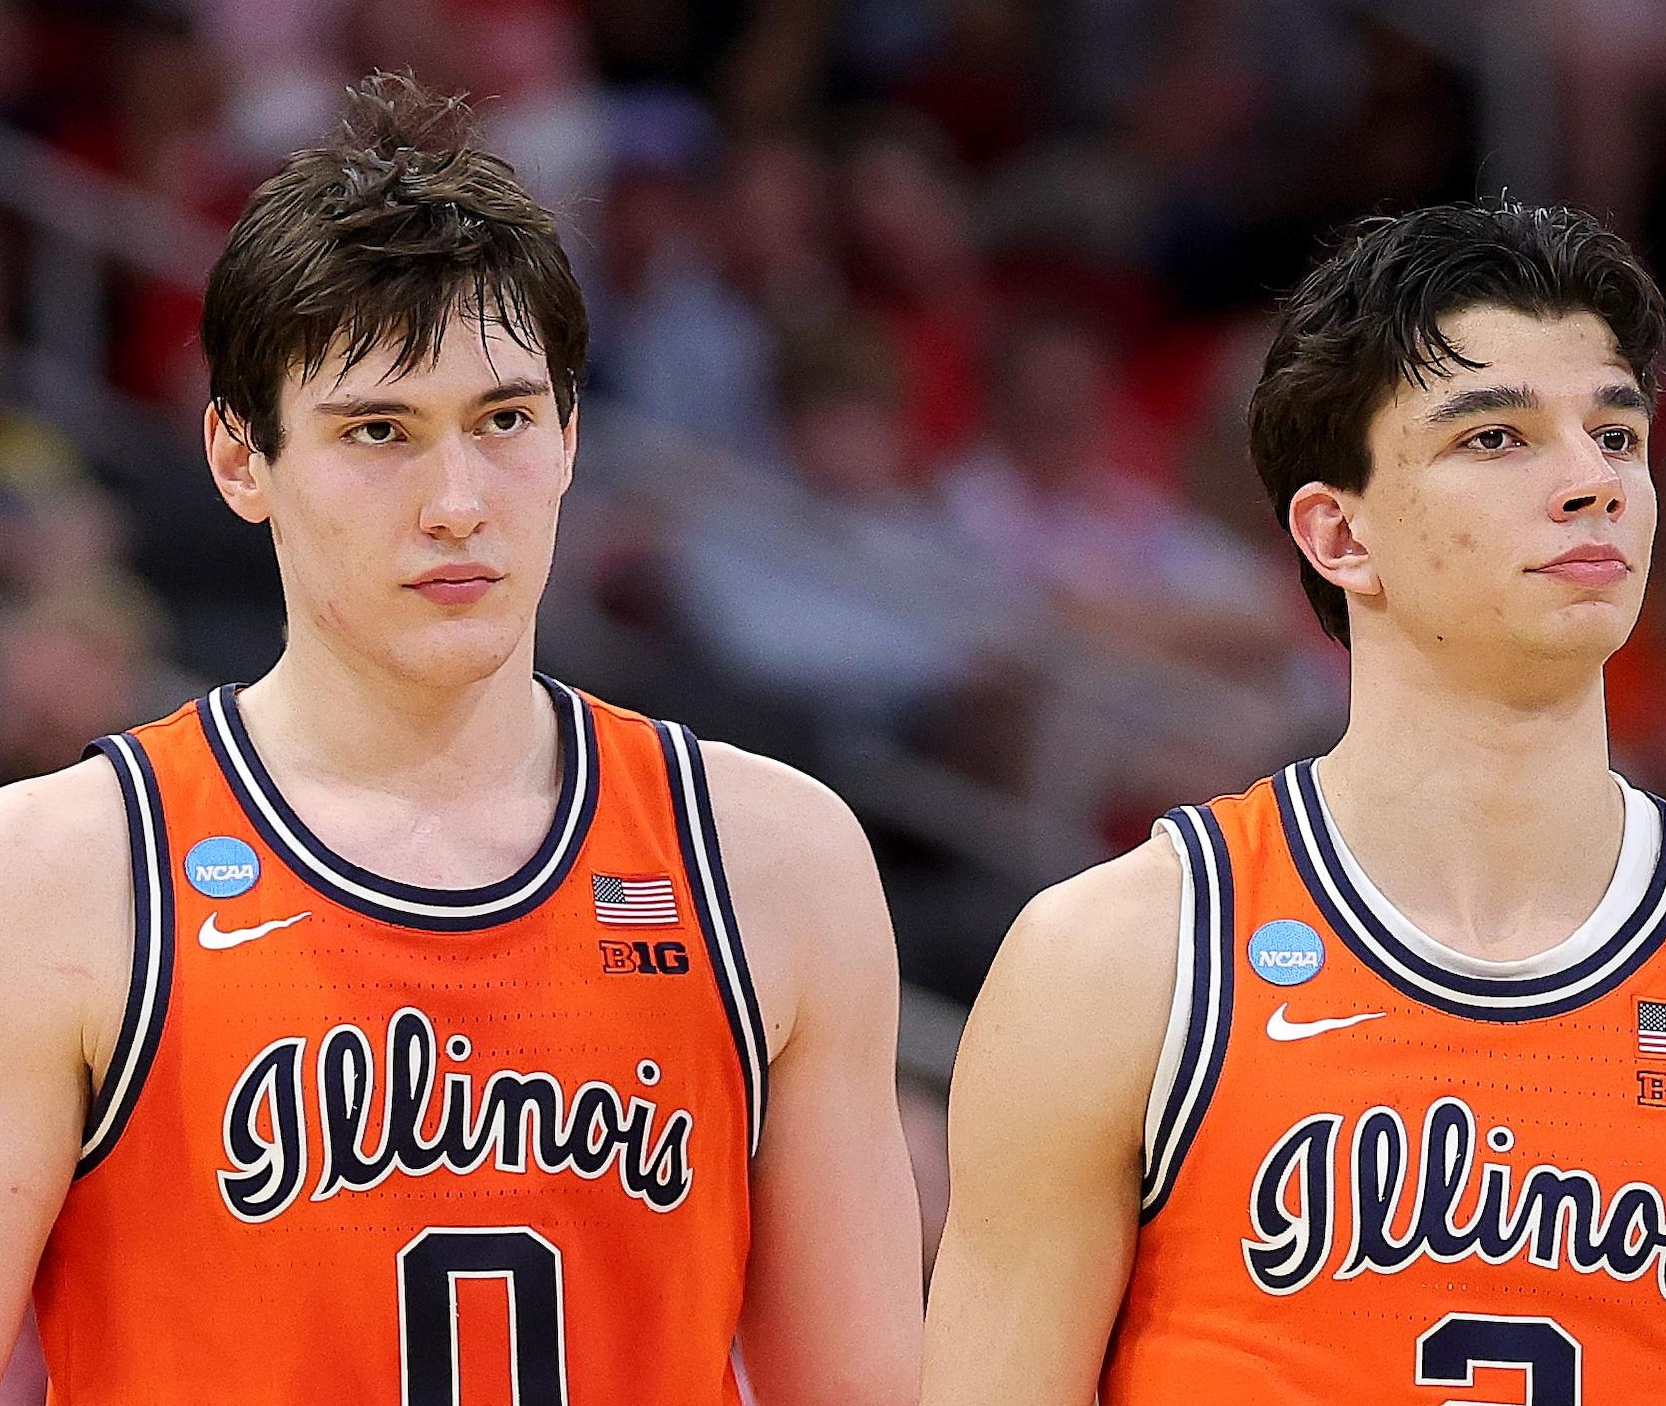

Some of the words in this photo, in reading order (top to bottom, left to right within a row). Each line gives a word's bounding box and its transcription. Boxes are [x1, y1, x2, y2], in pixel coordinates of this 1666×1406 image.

[195, 864, 254, 882] NCAA
[1259, 950, 1319, 968] NCAA
[217, 1007, 694, 1224] Illinois
